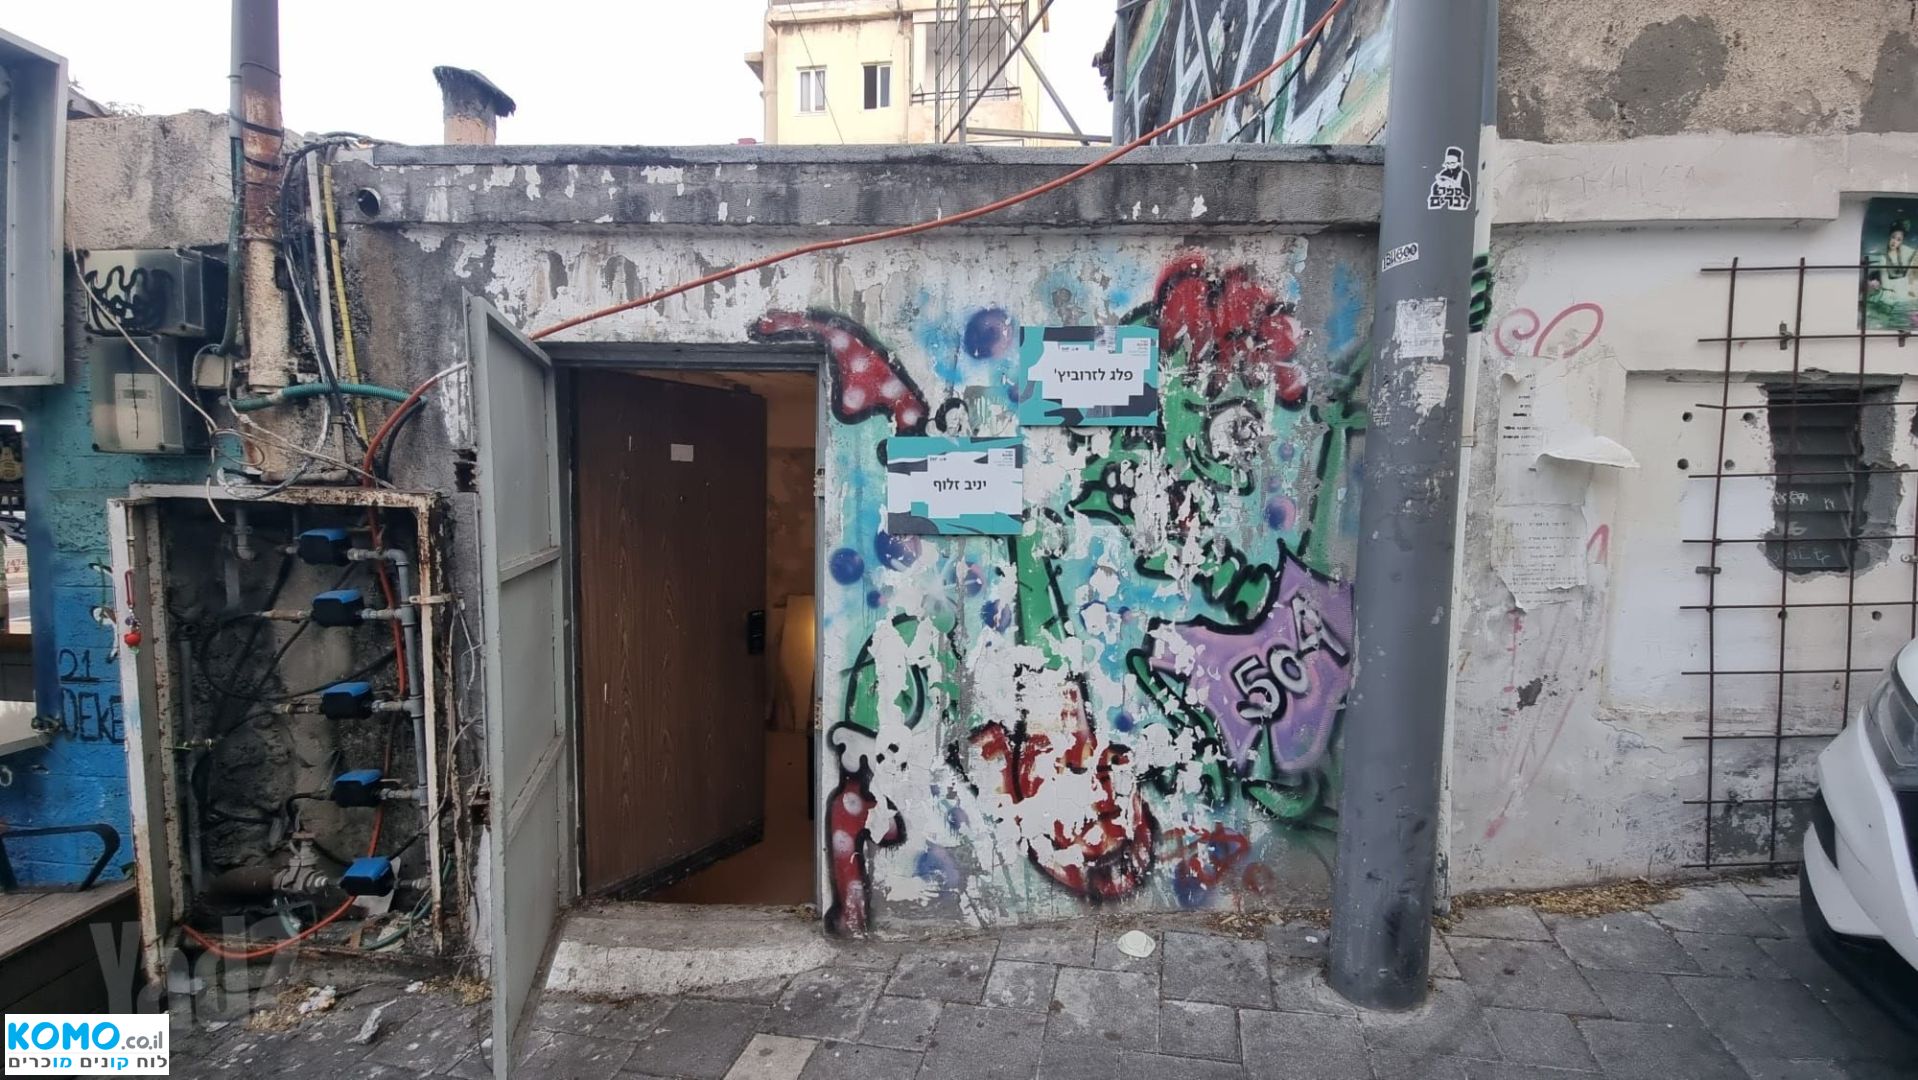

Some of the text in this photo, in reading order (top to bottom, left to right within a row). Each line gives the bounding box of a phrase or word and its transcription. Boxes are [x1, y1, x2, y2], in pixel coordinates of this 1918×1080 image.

[1430, 196, 1469, 208] דברים
[1054, 368, 1133, 383] פלג לזרוביץ'
[933, 478, 987, 492] יניב זלוף
[59, 648, 91, 681] 21
